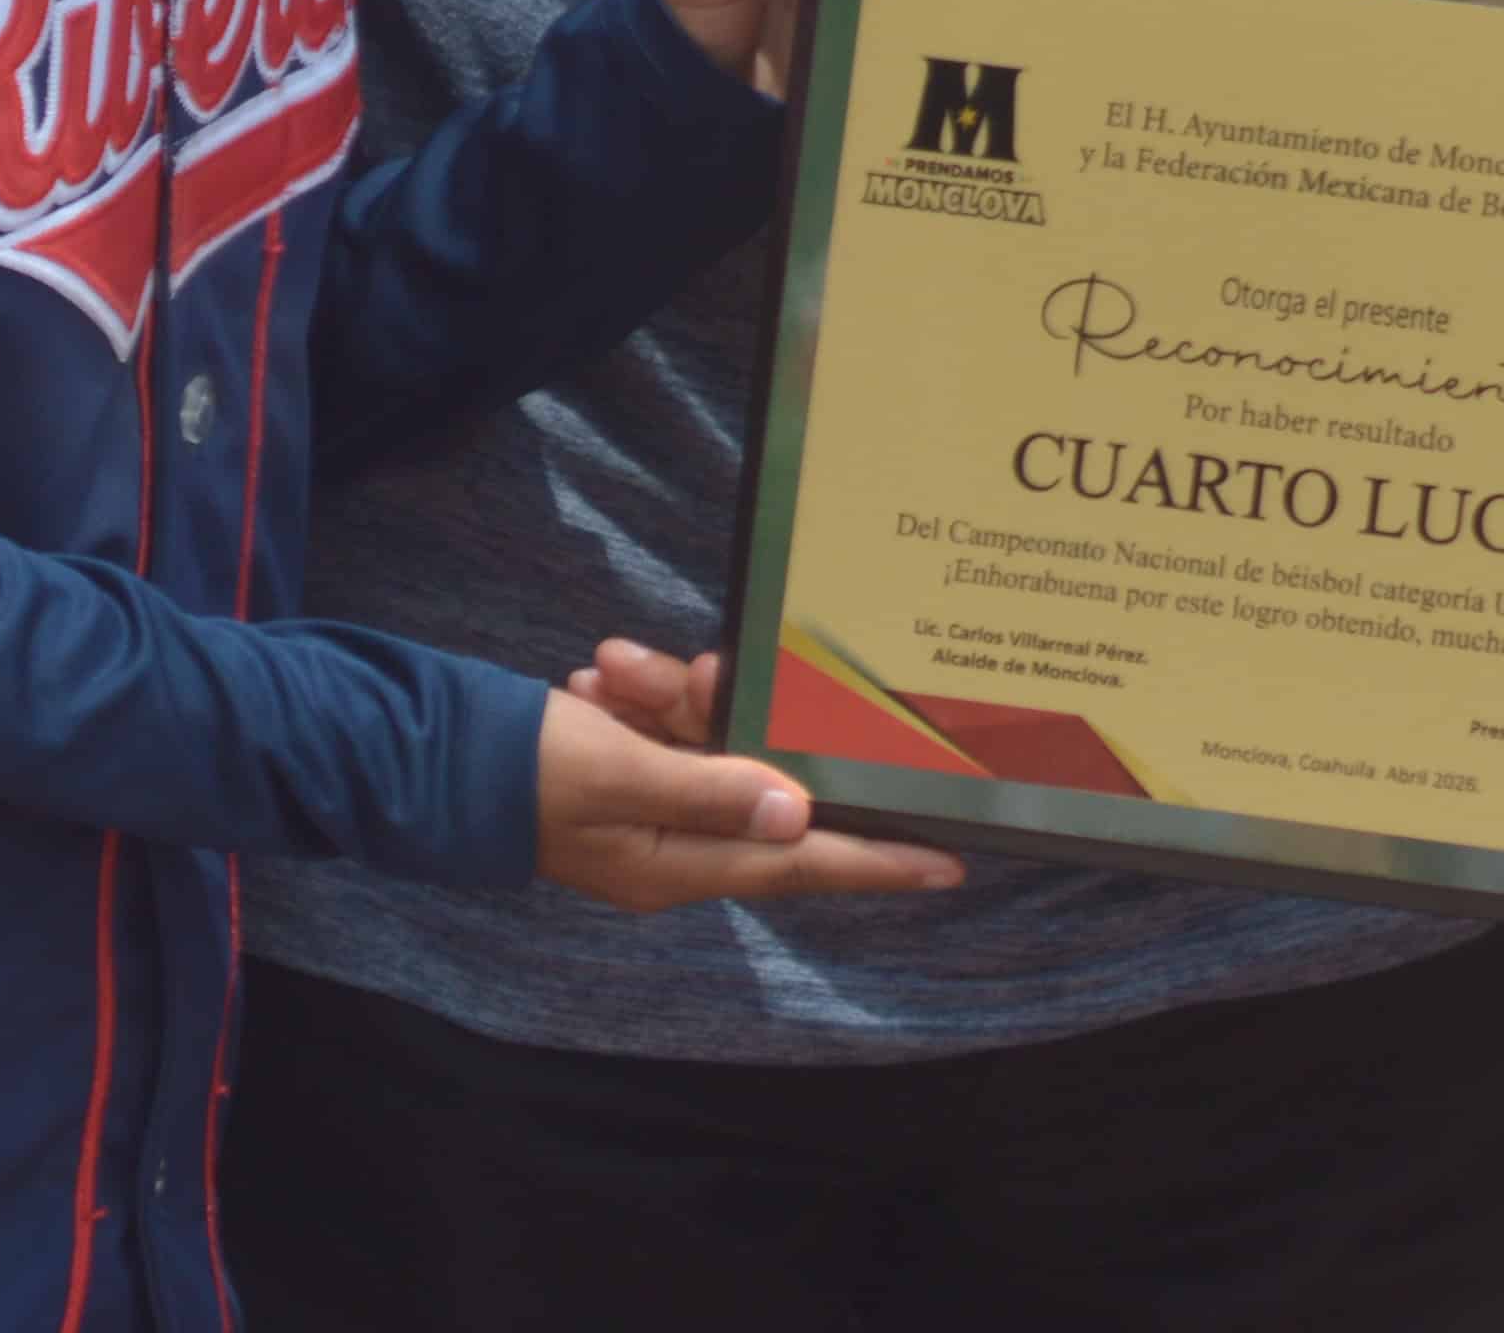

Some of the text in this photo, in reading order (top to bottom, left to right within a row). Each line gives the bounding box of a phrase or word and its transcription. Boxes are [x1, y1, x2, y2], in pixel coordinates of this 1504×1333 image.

[1106, 101, 1133, 129] El
[1142, 106, 1174, 134] H.
[1184, 112, 1380, 161] Ayuntamiento
[1387, 136, 1421, 165] de
[862, 172, 1046, 227] MONCLOVA
[905, 158, 1014, 185] PRENDAMOS
[1079, 145, 1096, 173] y
[1104, 141, 1126, 171] la
[1136, 146, 1289, 191] Federación
[1297, 167, 1431, 209] Mexicana
[1439, 186, 1472, 213] de
[1221, 277, 1449, 333] Otorga el presente
[1185, 393, 1455, 452] Por haber resultado
[1012, 432, 1339, 528] CUARTO
[897, 513, 940, 541] Del
[949, 519, 1105, 562] Campeonato
[1113, 540, 1225, 579] Nacional
[1234, 558, 1263, 583] de
[1271, 562, 1363, 597] béisbol
[1370, 580, 1485, 613] categoría
[944, 558, 1117, 603] ¡Enhorabuena
[1125, 587, 1168, 611] por
[1175, 593, 1224, 616] este
[1232, 595, 1297, 628] logro
[1305, 608, 1421, 647] obtenido,
[913, 618, 1149, 665] Lic. Carlos Villarreal Pérez.
[932, 647, 1124, 688] Alcalde de Monclova.
[1200, 741, 1293, 771] Monclova,
[1385, 765, 1427, 786] Abril
